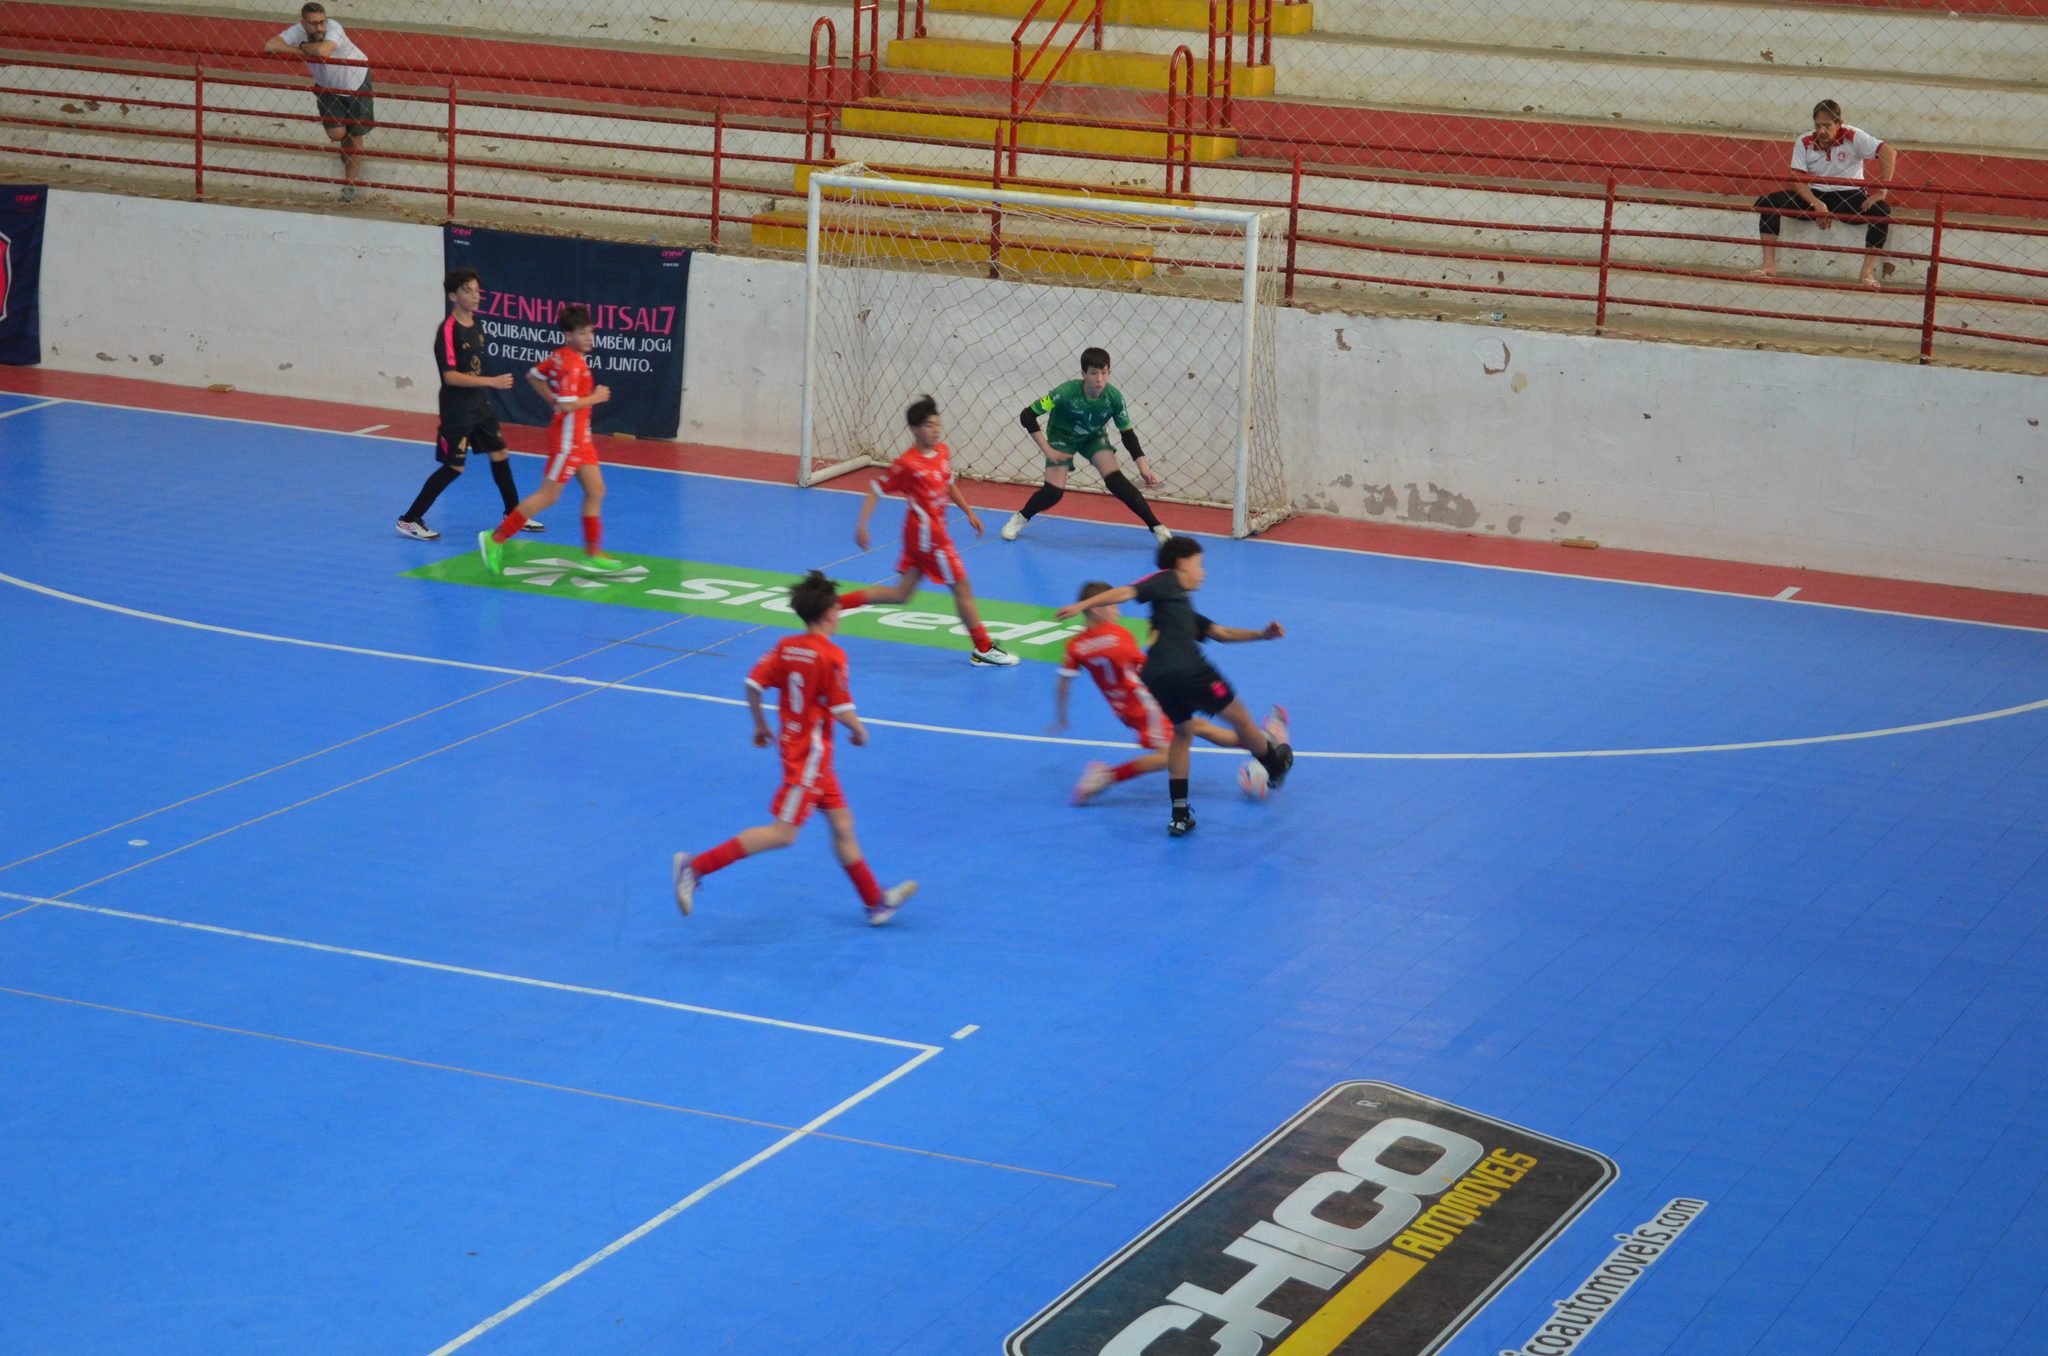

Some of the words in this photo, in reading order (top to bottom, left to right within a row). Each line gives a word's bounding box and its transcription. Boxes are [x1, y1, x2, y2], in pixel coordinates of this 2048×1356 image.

[474, 288, 675, 335] EZENHUTSAL7
[480, 320, 568, 345] RQUIBANCAD
[592, 334, 635, 351] AMBÉM
[638, 339, 671, 353] JOGA
[488, 342, 499, 356] O
[502, 344, 554, 363] REZENH
[606, 357, 653, 373] JUNTO.
[788, 671, 805, 714] 6
[1088, 656, 1117, 686] 7
[1099, 1117, 1484, 1356] CHICO
[1504, 1198, 1704, 1356] coautomoveis.com
